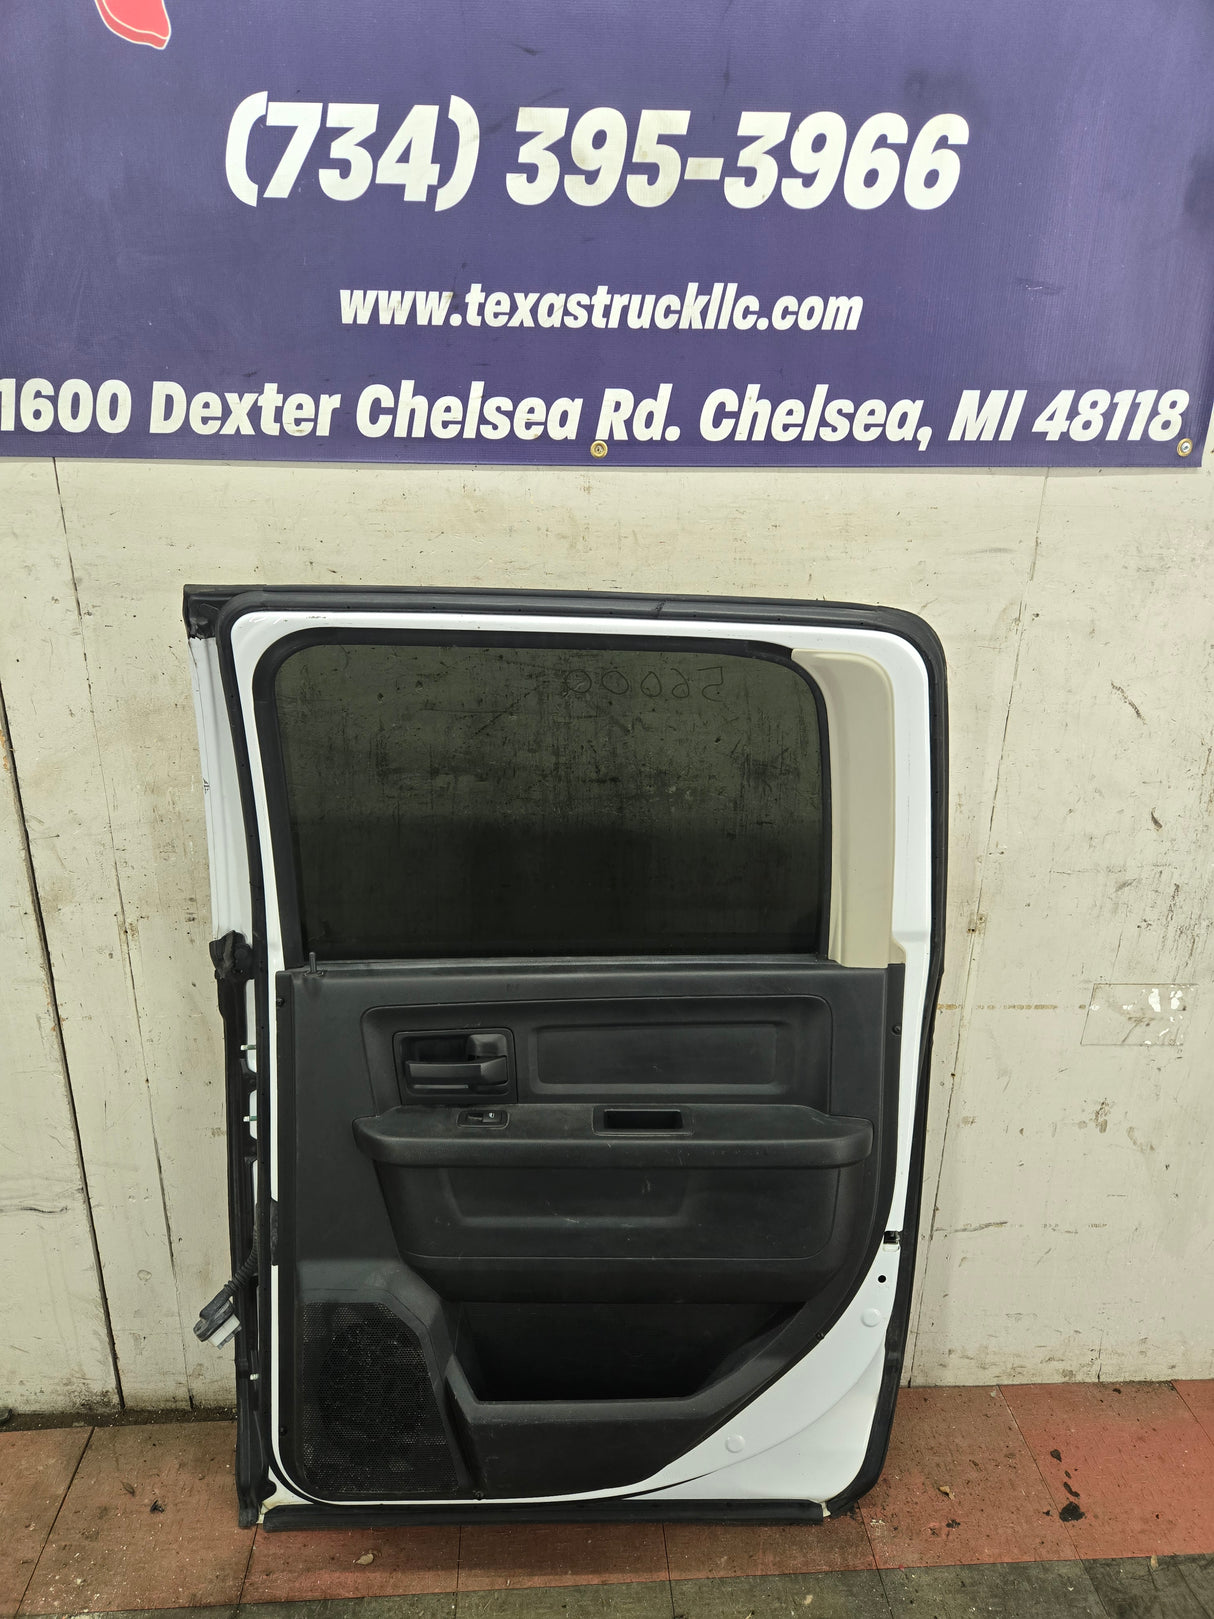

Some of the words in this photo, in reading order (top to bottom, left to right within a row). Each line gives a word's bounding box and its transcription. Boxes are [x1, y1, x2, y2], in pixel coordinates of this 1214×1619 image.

[225, 91, 480, 211] (734)
[506, 106, 970, 211] 395-3966
[340, 282, 864, 331] www.texastruckllc.com
[0, 378, 132, 434] 1600
[150, 380, 341, 437] Dexter
[356, 380, 584, 441] Chelsea
[595, 383, 681, 442] Rd.
[700, 384, 932, 452] Chelsea,
[948, 389, 1028, 442] MI
[1032, 388, 1190, 442] 48118
